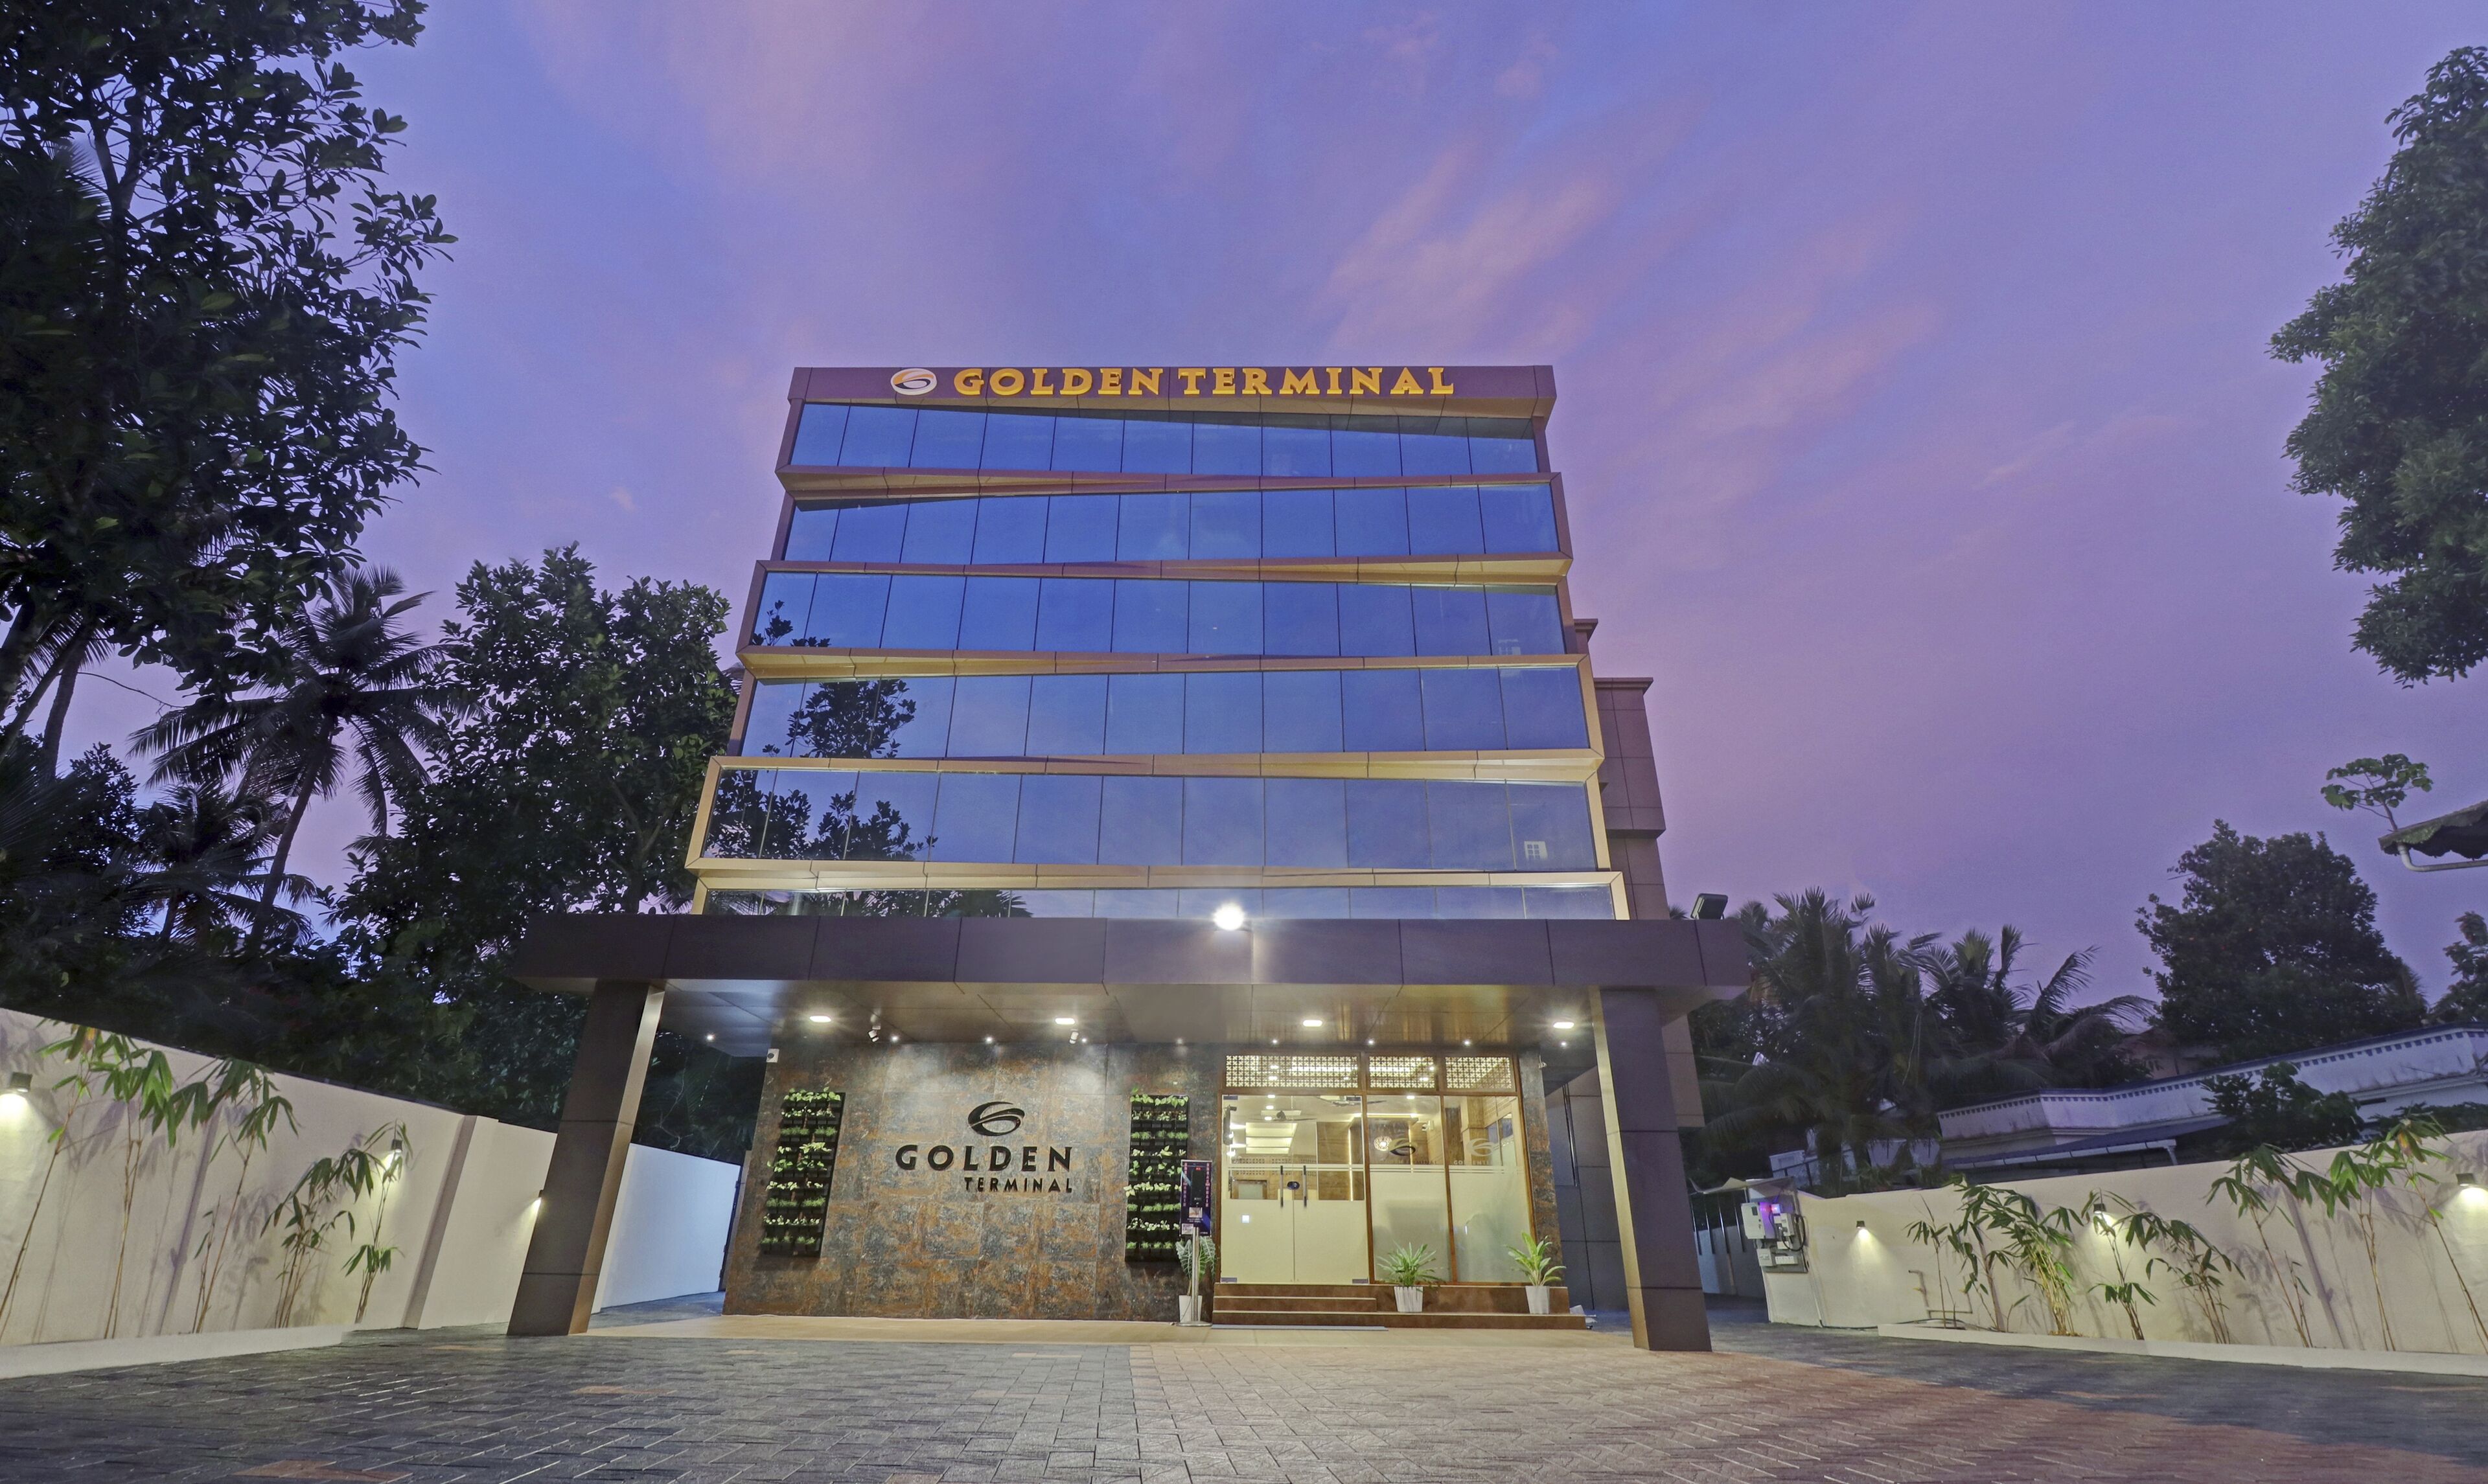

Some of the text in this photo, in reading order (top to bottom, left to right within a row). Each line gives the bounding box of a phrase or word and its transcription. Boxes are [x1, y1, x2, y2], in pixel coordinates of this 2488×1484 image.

[953, 367, 1455, 396] GOLDEN TERMINAL
[895, 1144, 1073, 1172] GOLDEN
[963, 1176, 1073, 1193] TERMINAL
